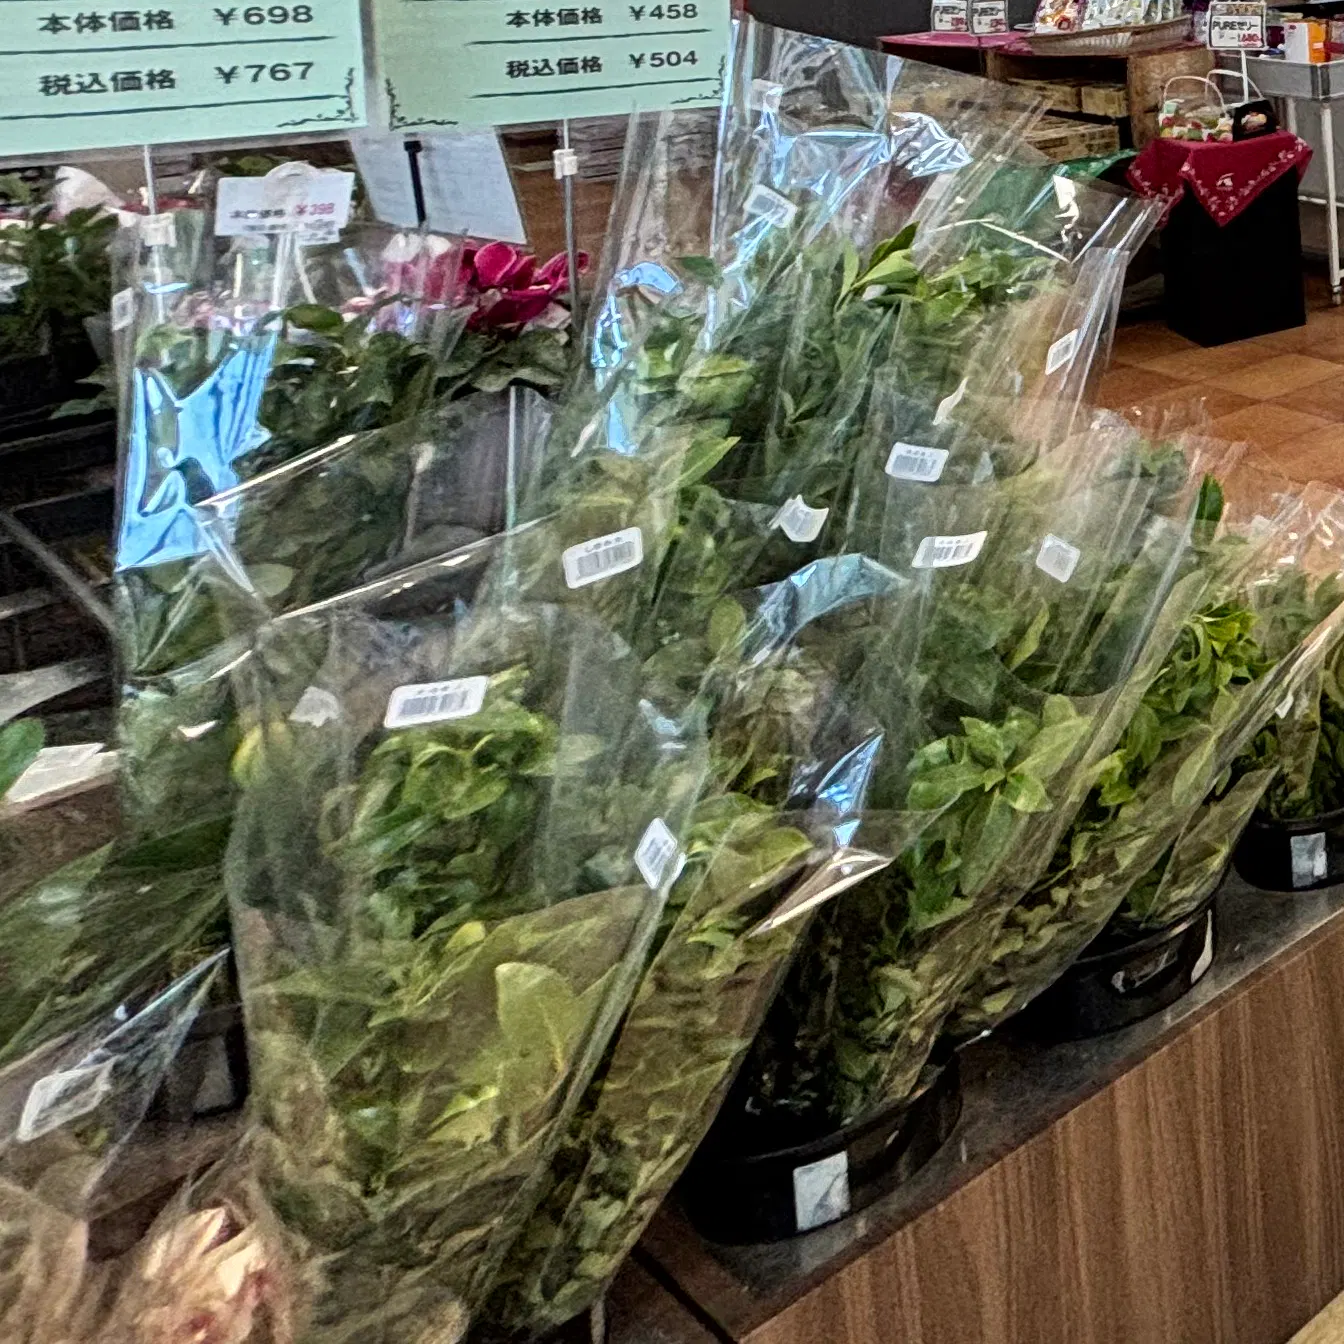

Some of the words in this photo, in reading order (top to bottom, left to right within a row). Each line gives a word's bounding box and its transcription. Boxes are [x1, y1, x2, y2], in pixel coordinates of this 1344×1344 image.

[39, 9, 174, 34] 本体価格
[214, 5, 314, 26] ¥698
[506, 7, 603, 28] 本体価格
[629, 3, 698, 22] ¥458
[505, 56, 603, 78] 税込価格
[629, 50, 698, 69] ¥504
[39, 69, 176, 96] 税込価格
[215, 62, 314, 84] ¥767
